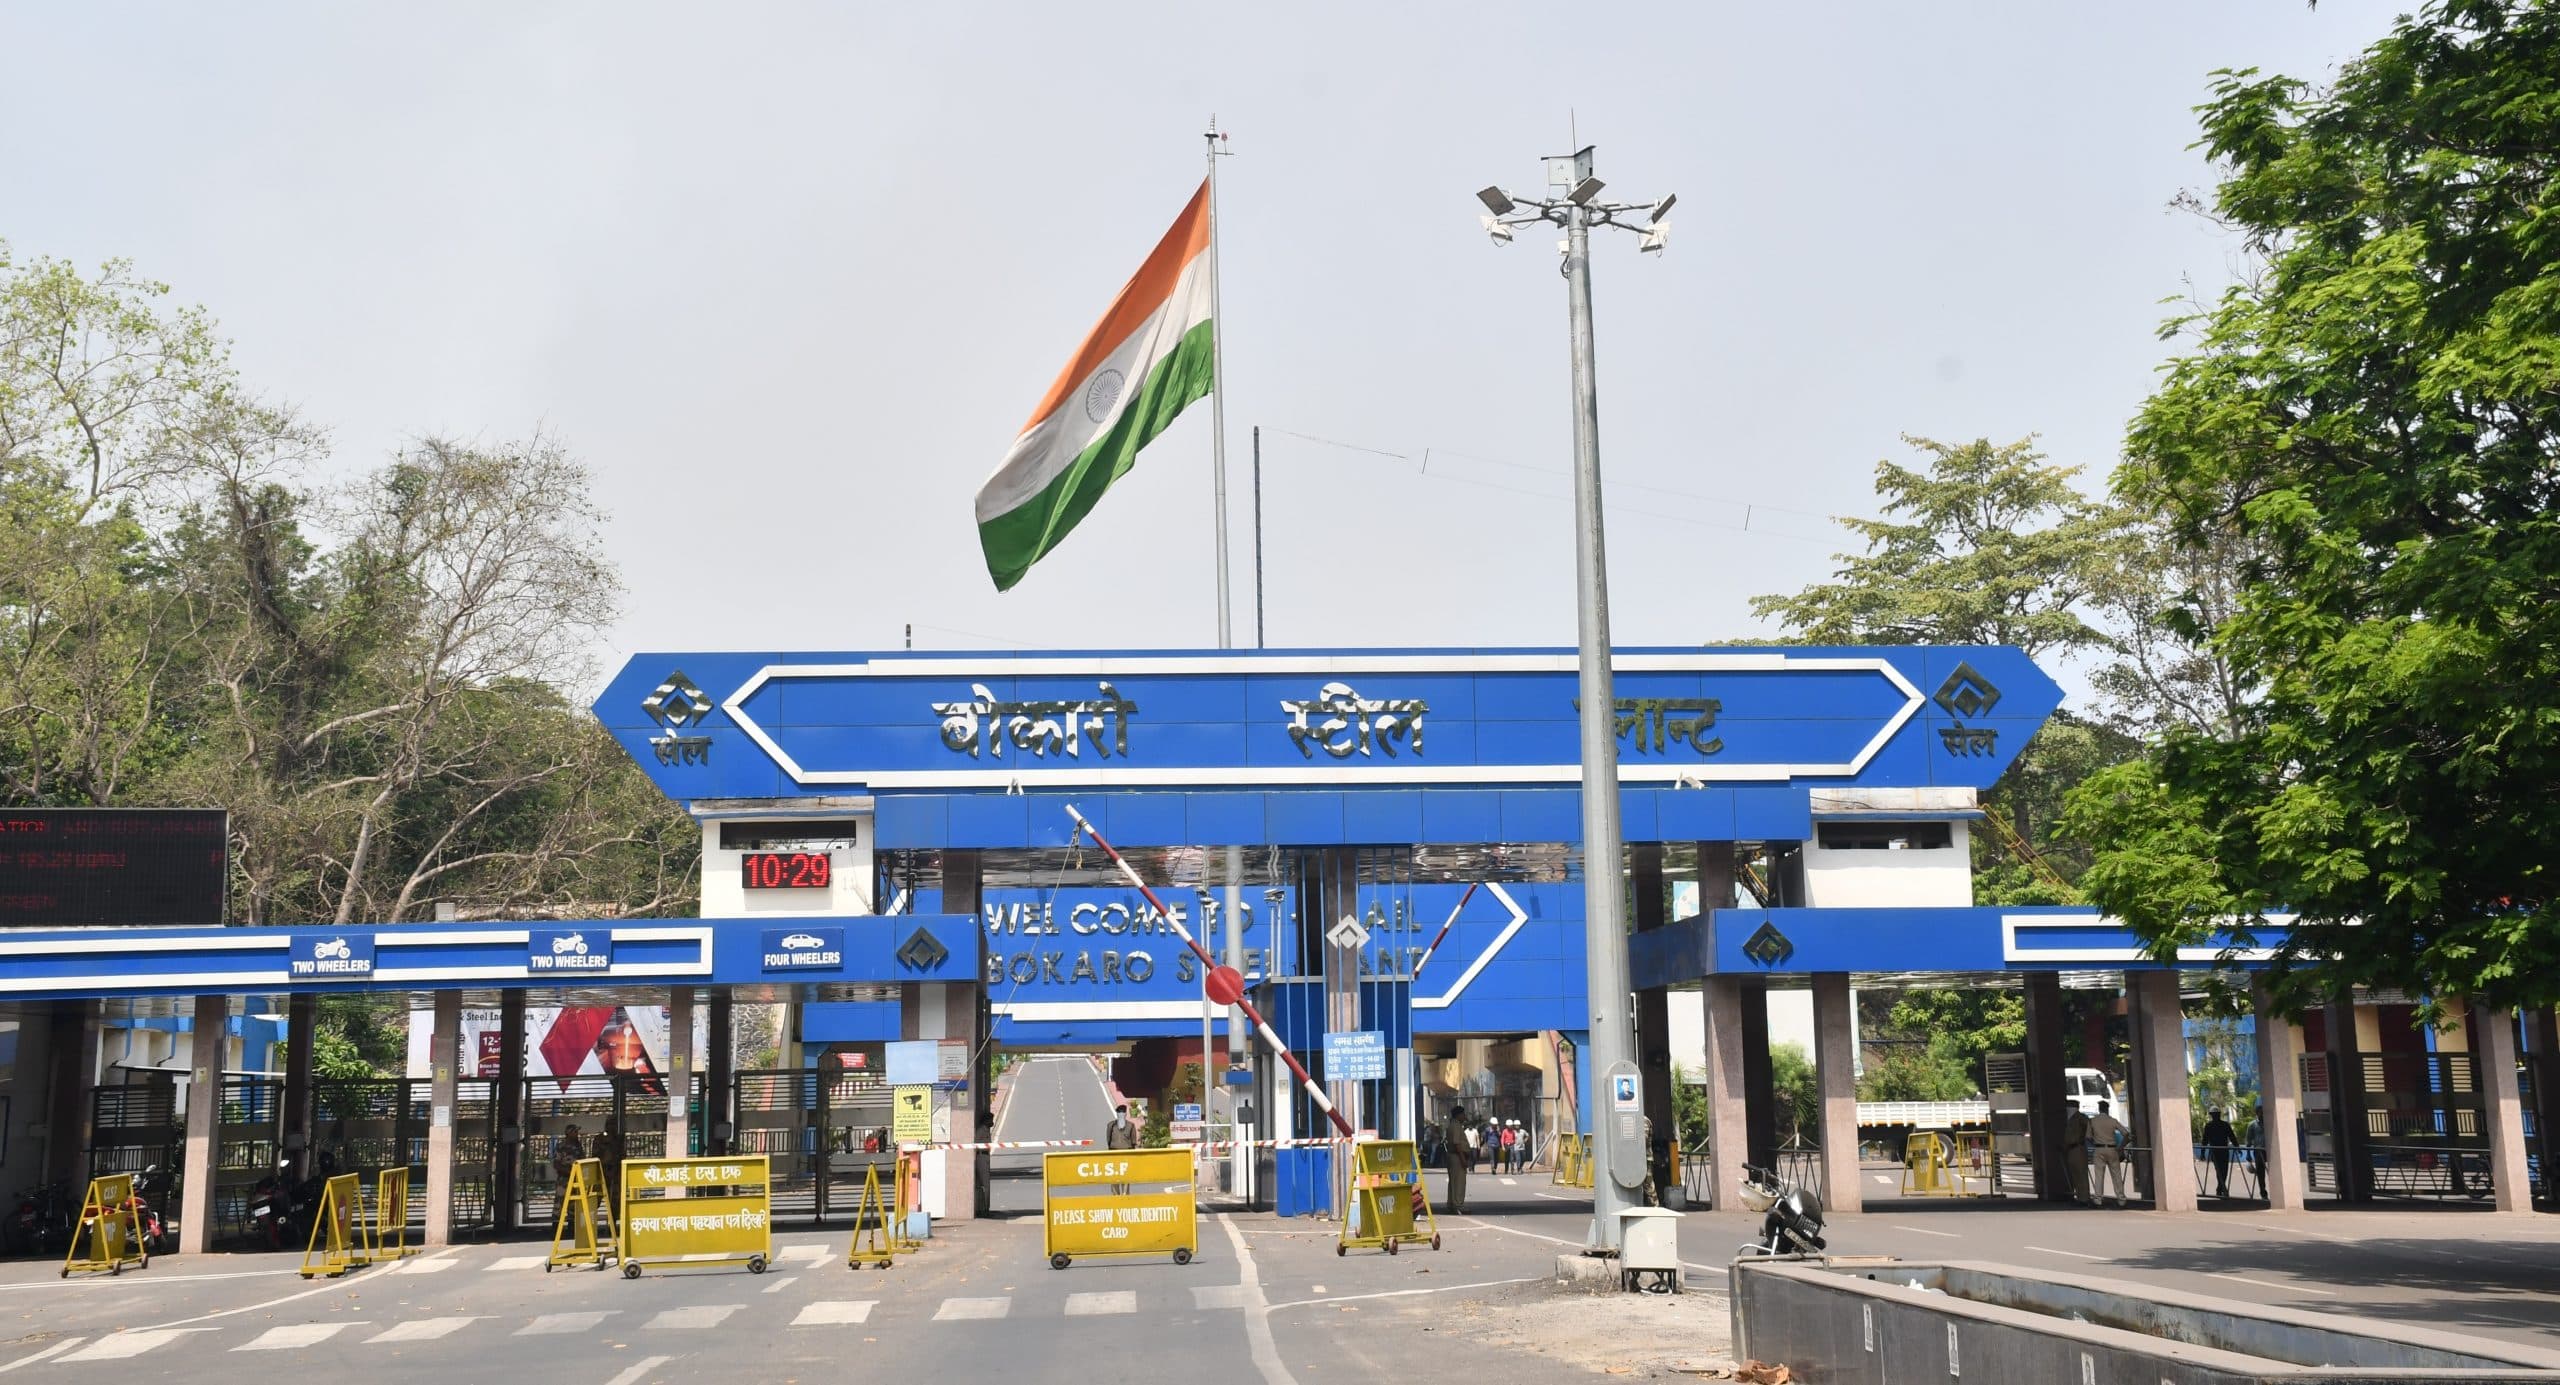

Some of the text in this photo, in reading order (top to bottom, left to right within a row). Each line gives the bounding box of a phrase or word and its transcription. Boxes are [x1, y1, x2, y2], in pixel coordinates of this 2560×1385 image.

[931, 681, 1138, 760] बोकारो
[1280, 682, 1430, 760] स्टील
[649, 728, 713, 767] सेल
[1938, 719, 1998, 759] सेल
[746, 853, 829, 887] 10:29
[292, 959, 371, 973] TWO WHEELERS
[531, 955, 608, 968] TWO WHEELERS
[764, 951, 840, 966] FOUR WHEELERS
[987, 951, 1154, 984] BOKARO
[1379, 1195, 1395, 1215] STOP
[1053, 1206, 1179, 1226] PLEASE SHOW YOUR IDENTITY
[1101, 1226, 1129, 1239] CARD
